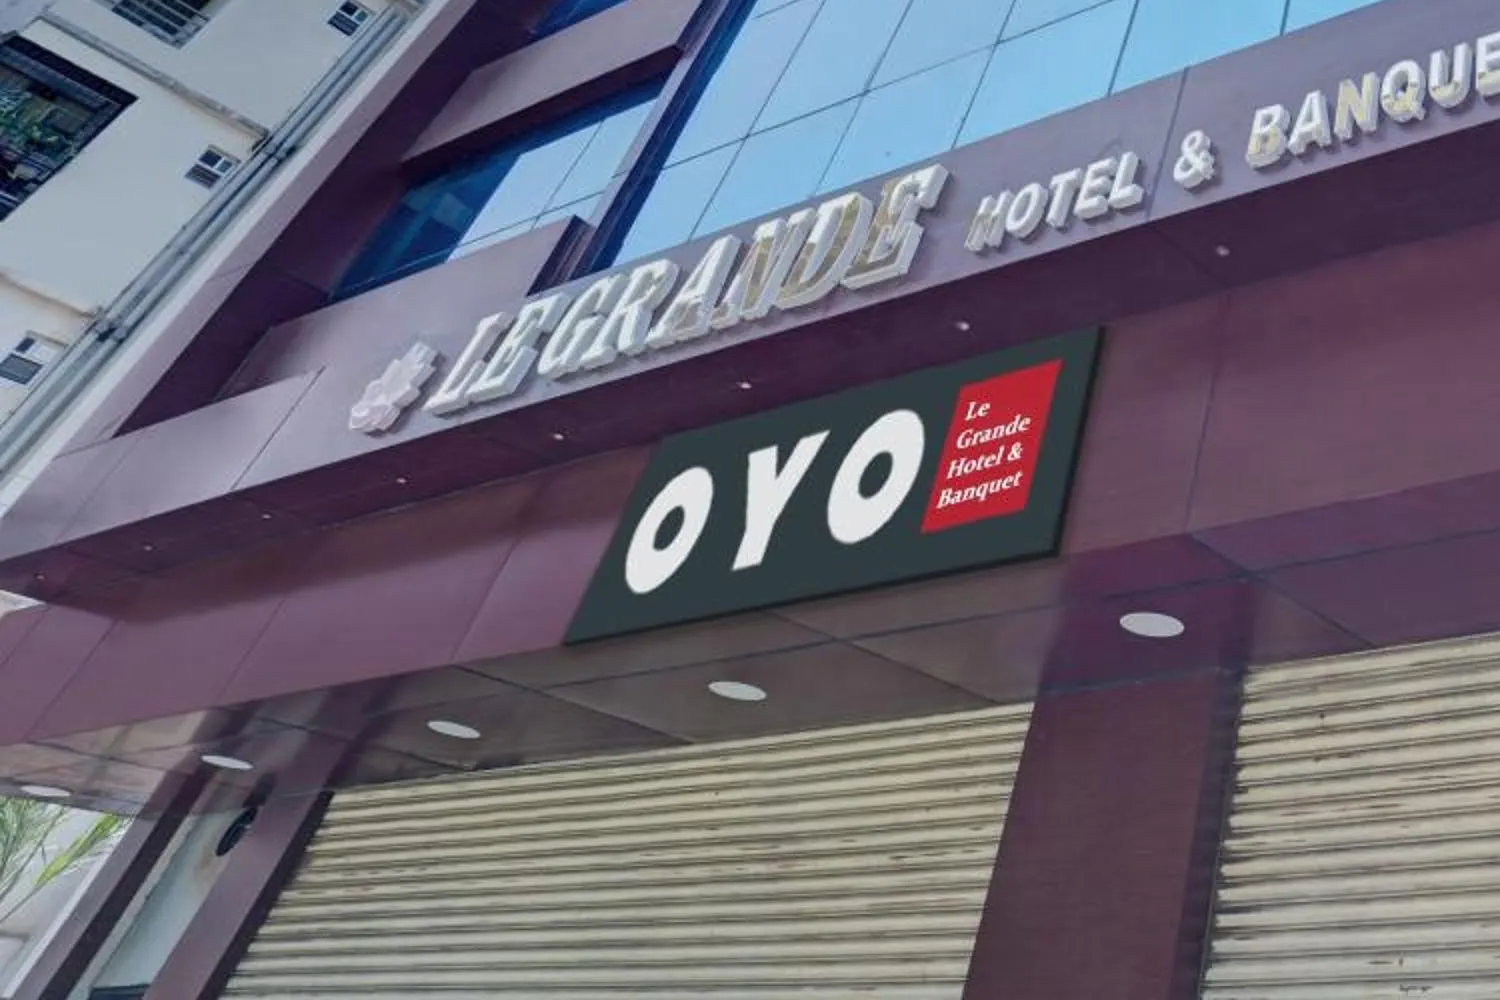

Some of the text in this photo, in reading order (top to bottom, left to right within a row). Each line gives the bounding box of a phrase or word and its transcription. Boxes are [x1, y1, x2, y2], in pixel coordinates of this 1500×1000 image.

[963, 151, 1145, 253] HOTEL
[1172, 129, 1217, 190] &
[965, 400, 991, 421] Le
[956, 414, 1032, 449] Grande
[946, 441, 1024, 479] Hotel &
[624, 409, 925, 594] OYO
[935, 470, 1024, 509] Banquet
